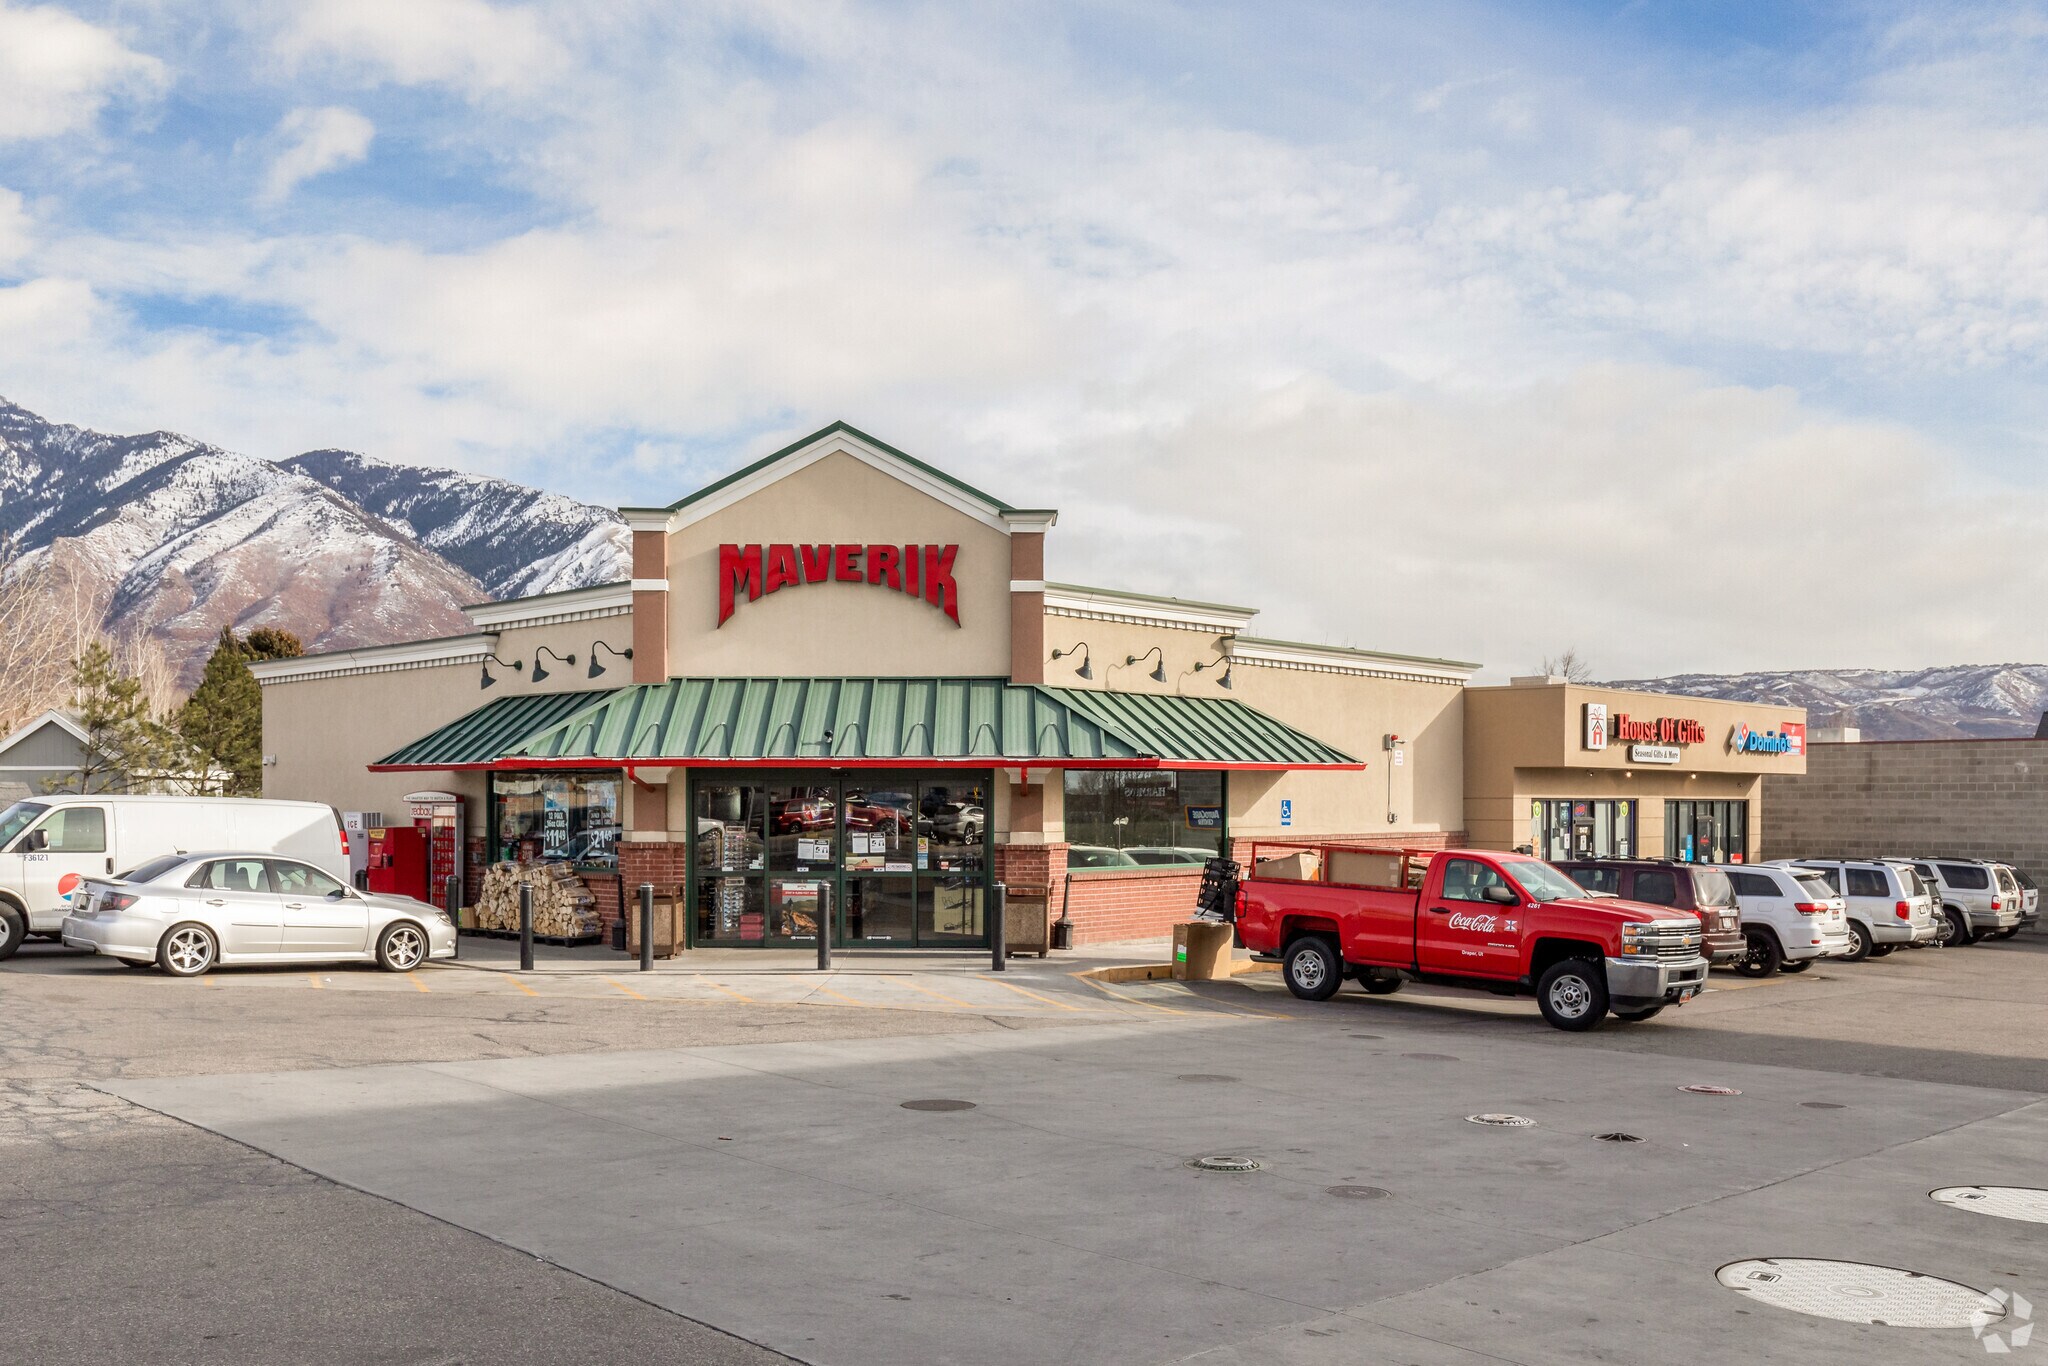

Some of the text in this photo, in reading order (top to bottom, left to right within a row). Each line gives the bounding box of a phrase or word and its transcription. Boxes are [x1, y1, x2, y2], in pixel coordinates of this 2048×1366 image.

[717, 543, 962, 629] MAVERIK
[1619, 713, 1706, 744] House Of Gifts
[1634, 748, 1653, 758] Seasonal
[1653, 750, 1663, 759] Gifts
[1668, 750, 1679, 760] More
[347, 820, 358, 829] ICE
[1461, 949, 1478, 957] Draper,
